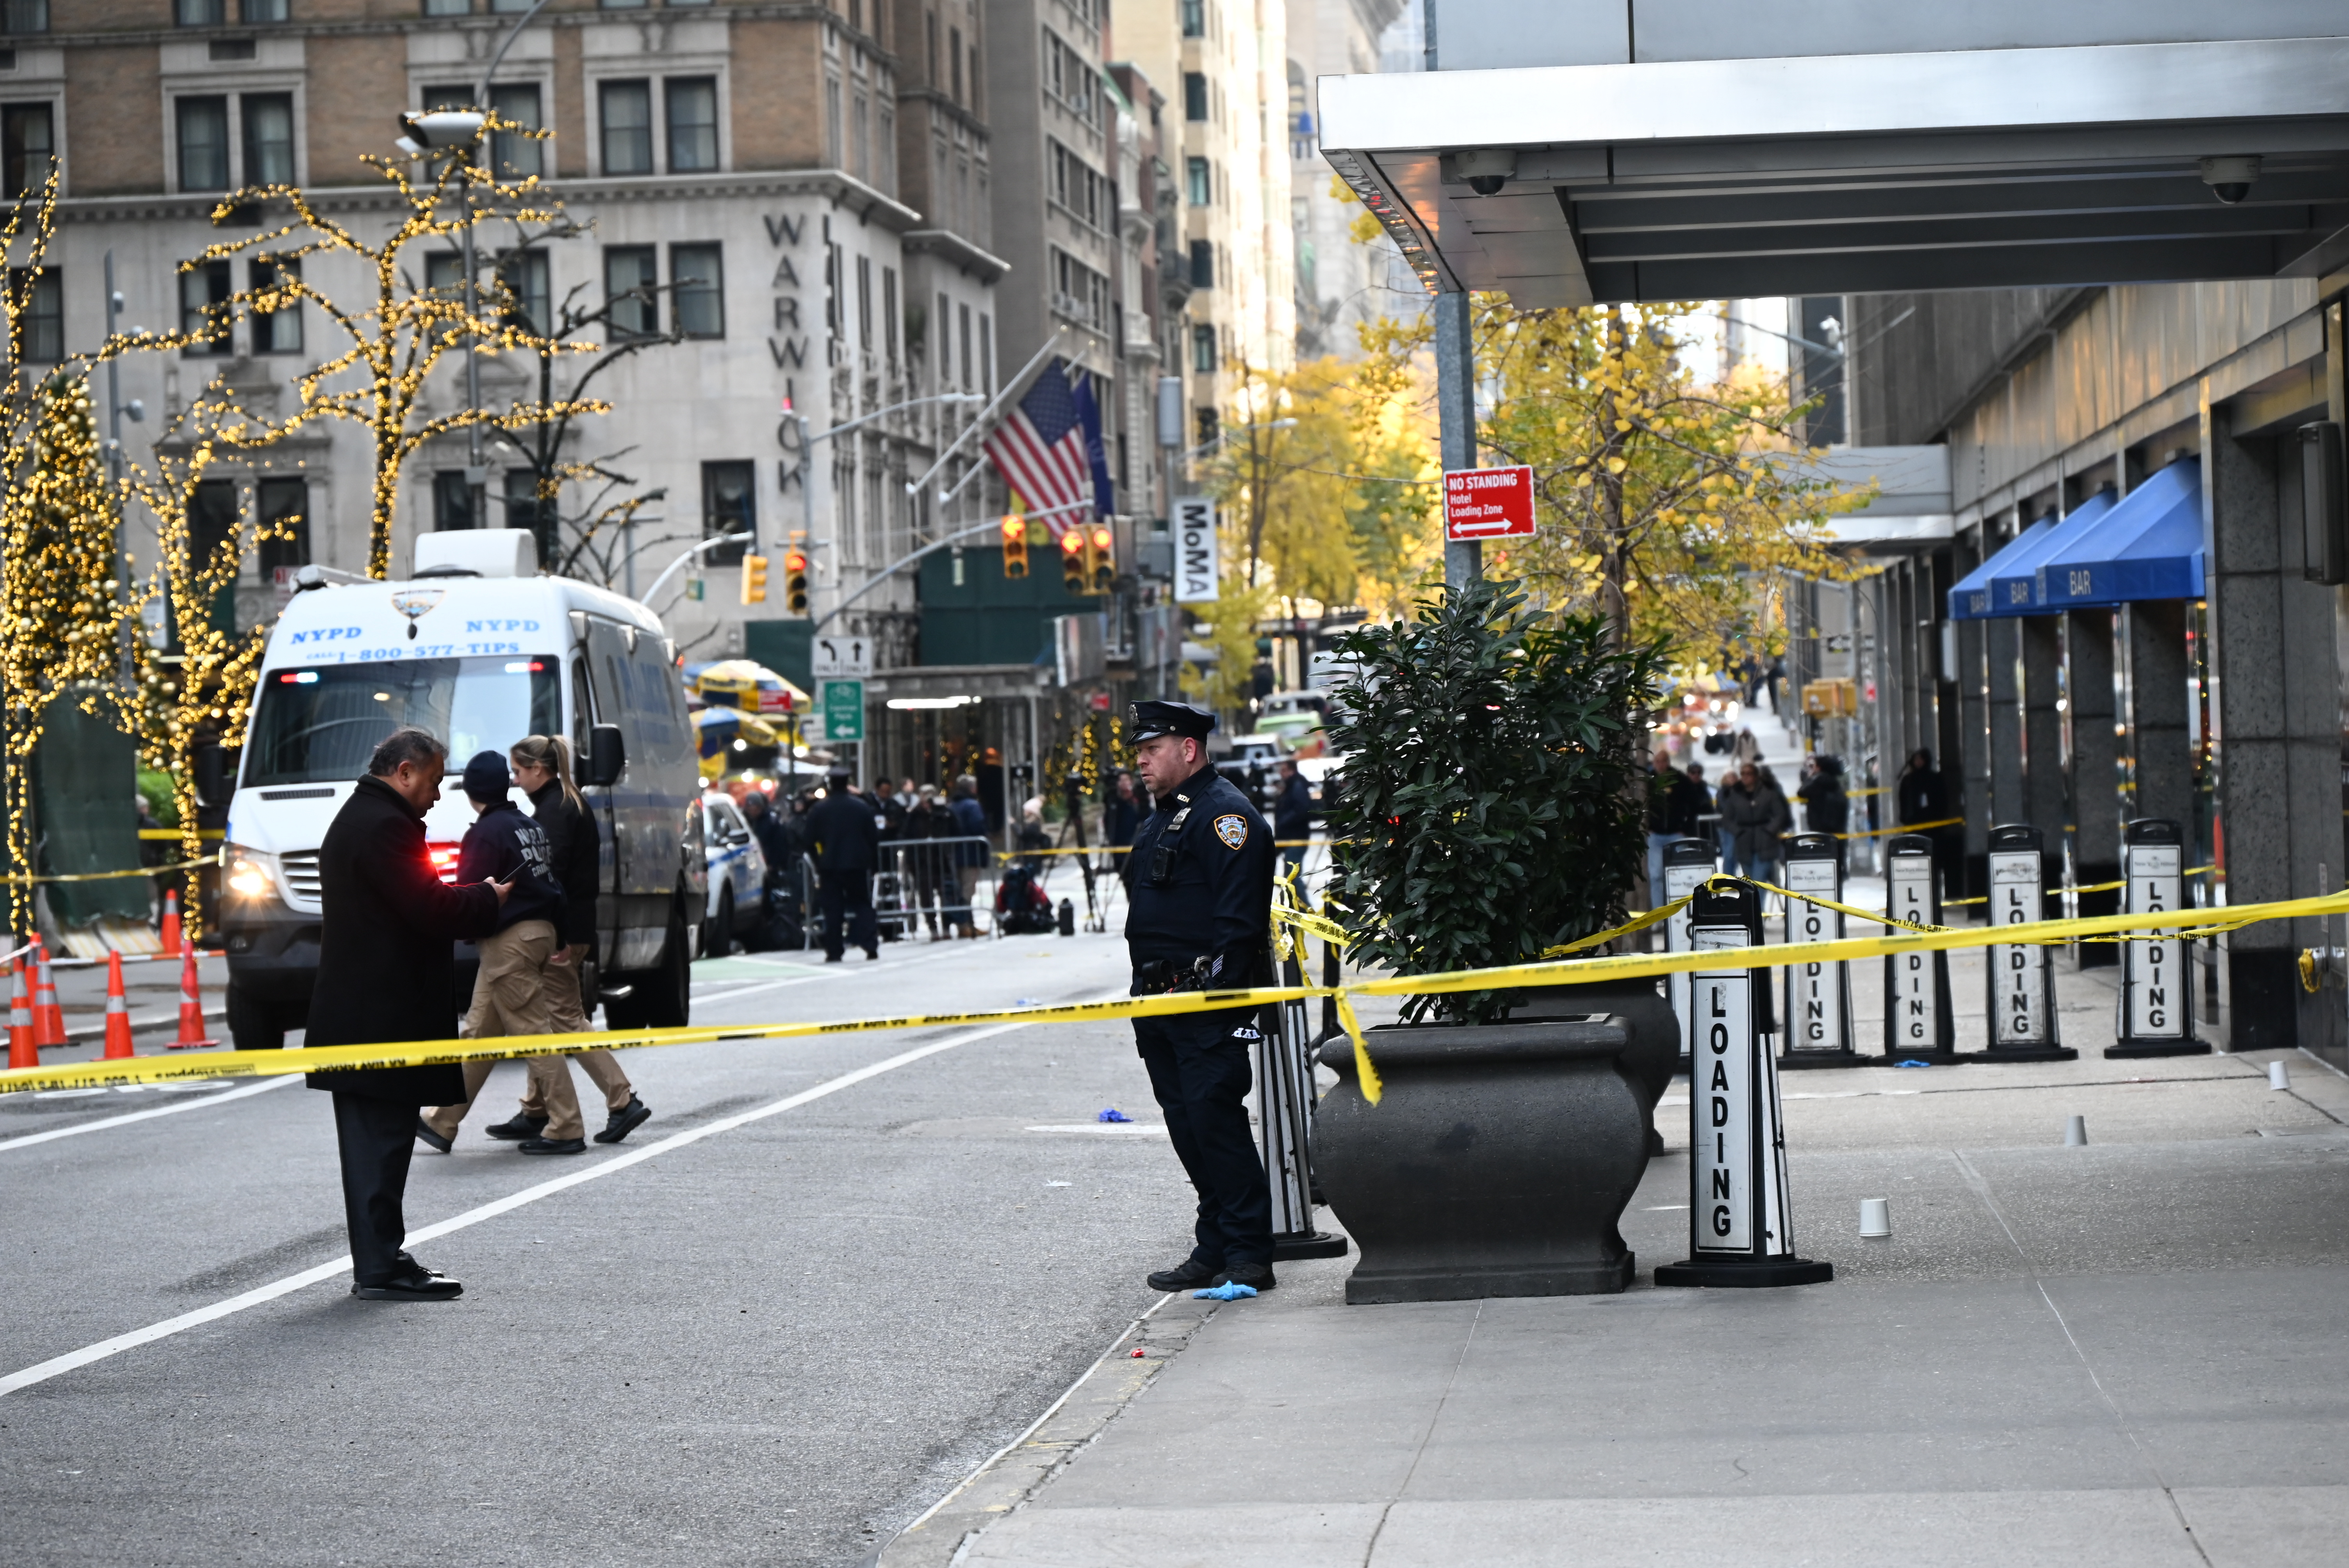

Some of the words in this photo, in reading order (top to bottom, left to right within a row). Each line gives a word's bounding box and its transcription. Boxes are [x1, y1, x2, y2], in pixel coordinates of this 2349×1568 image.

[763, 214, 809, 494] WARWICK
[1449, 477, 1464, 490] NO
[1466, 473, 1518, 490] STANDING
[1451, 493, 1472, 504] Hotel
[1451, 505, 1482, 517] Loading
[1484, 504, 1503, 515] Zone
[1183, 505, 1209, 595] MoMA
[2011, 582, 2028, 604] BAR
[2070, 570, 2091, 596] BAR
[291, 627, 362, 645] NYPD
[466, 619, 541, 633] NYPD
[337, 642, 520, 663] 1-800-577-TIPS
[1805, 893, 1824, 1040] LODING
[1908, 887, 1924, 1038] LODING
[2010, 888, 2028, 1034] LODING
[1710, 986, 1731, 1237] LOADING
